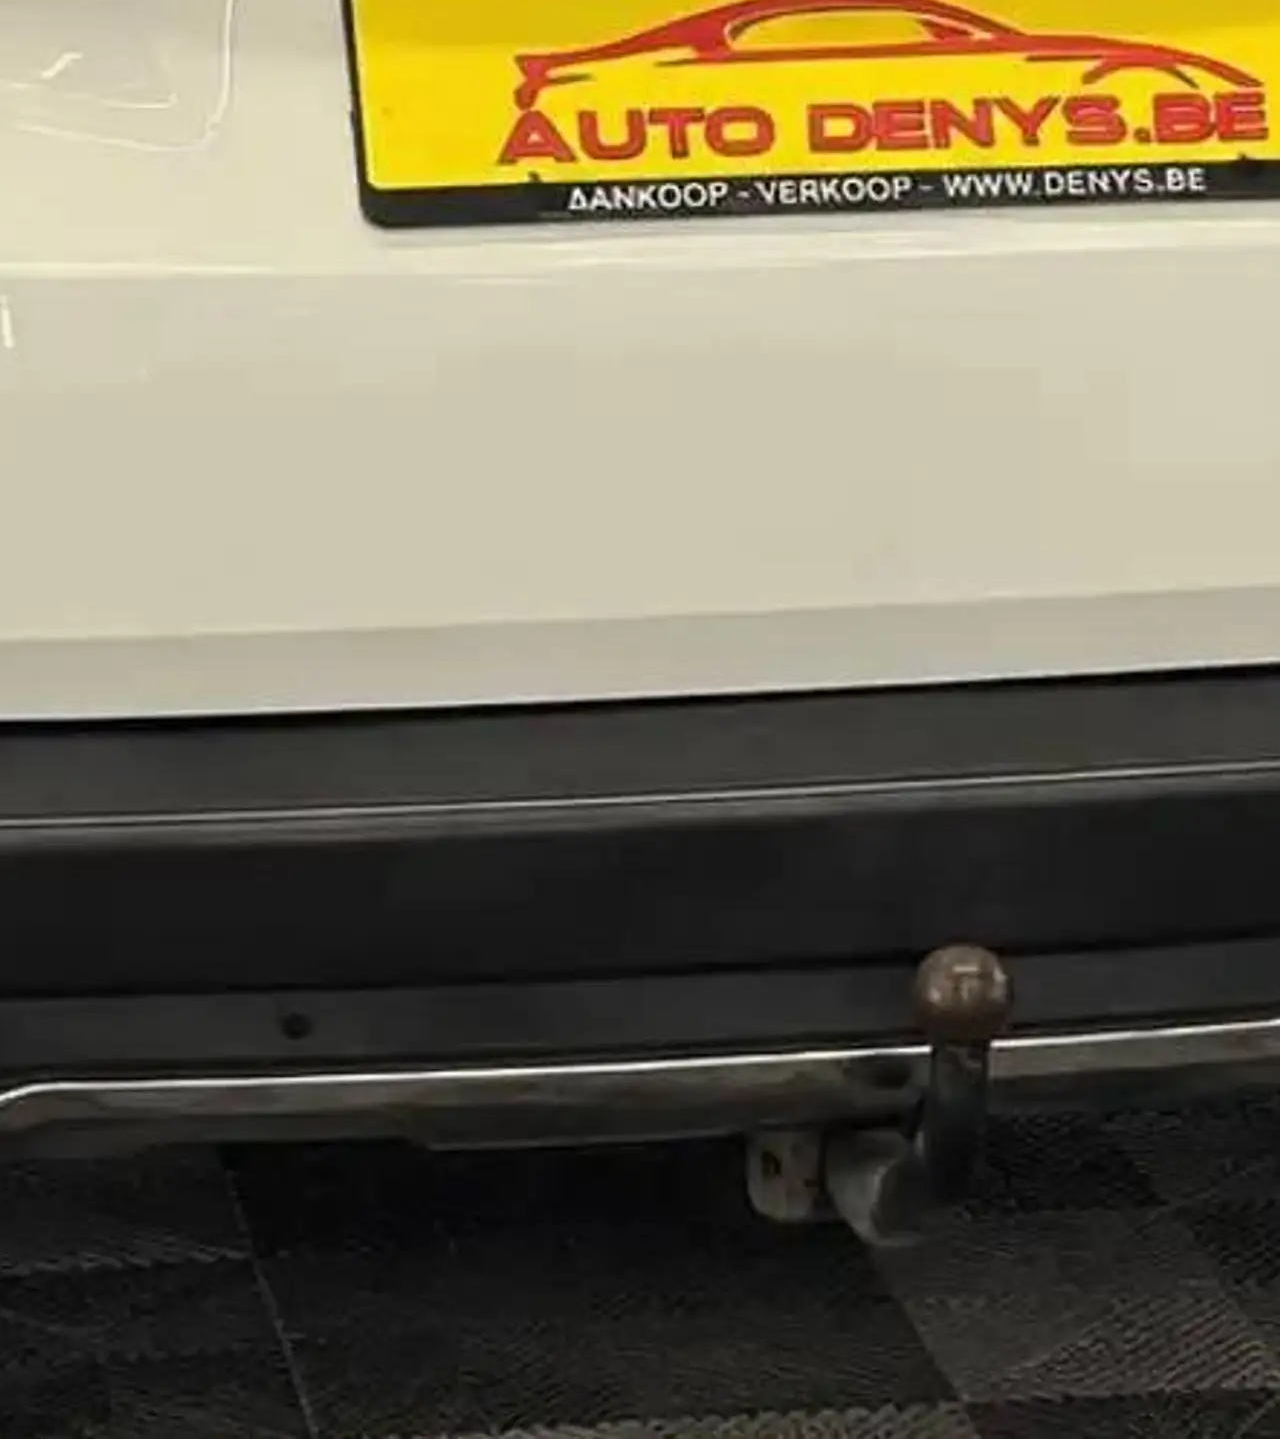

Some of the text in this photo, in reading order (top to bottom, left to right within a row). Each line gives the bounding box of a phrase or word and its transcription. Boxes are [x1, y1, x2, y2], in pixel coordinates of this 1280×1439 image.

[496, 92, 1269, 165] AUTO DENYS.BE
[567, 181, 729, 211] AANKOOP
[753, 175, 913, 206] VERKOOP
[941, 166, 1209, 199] WWW.DENYS.BE
